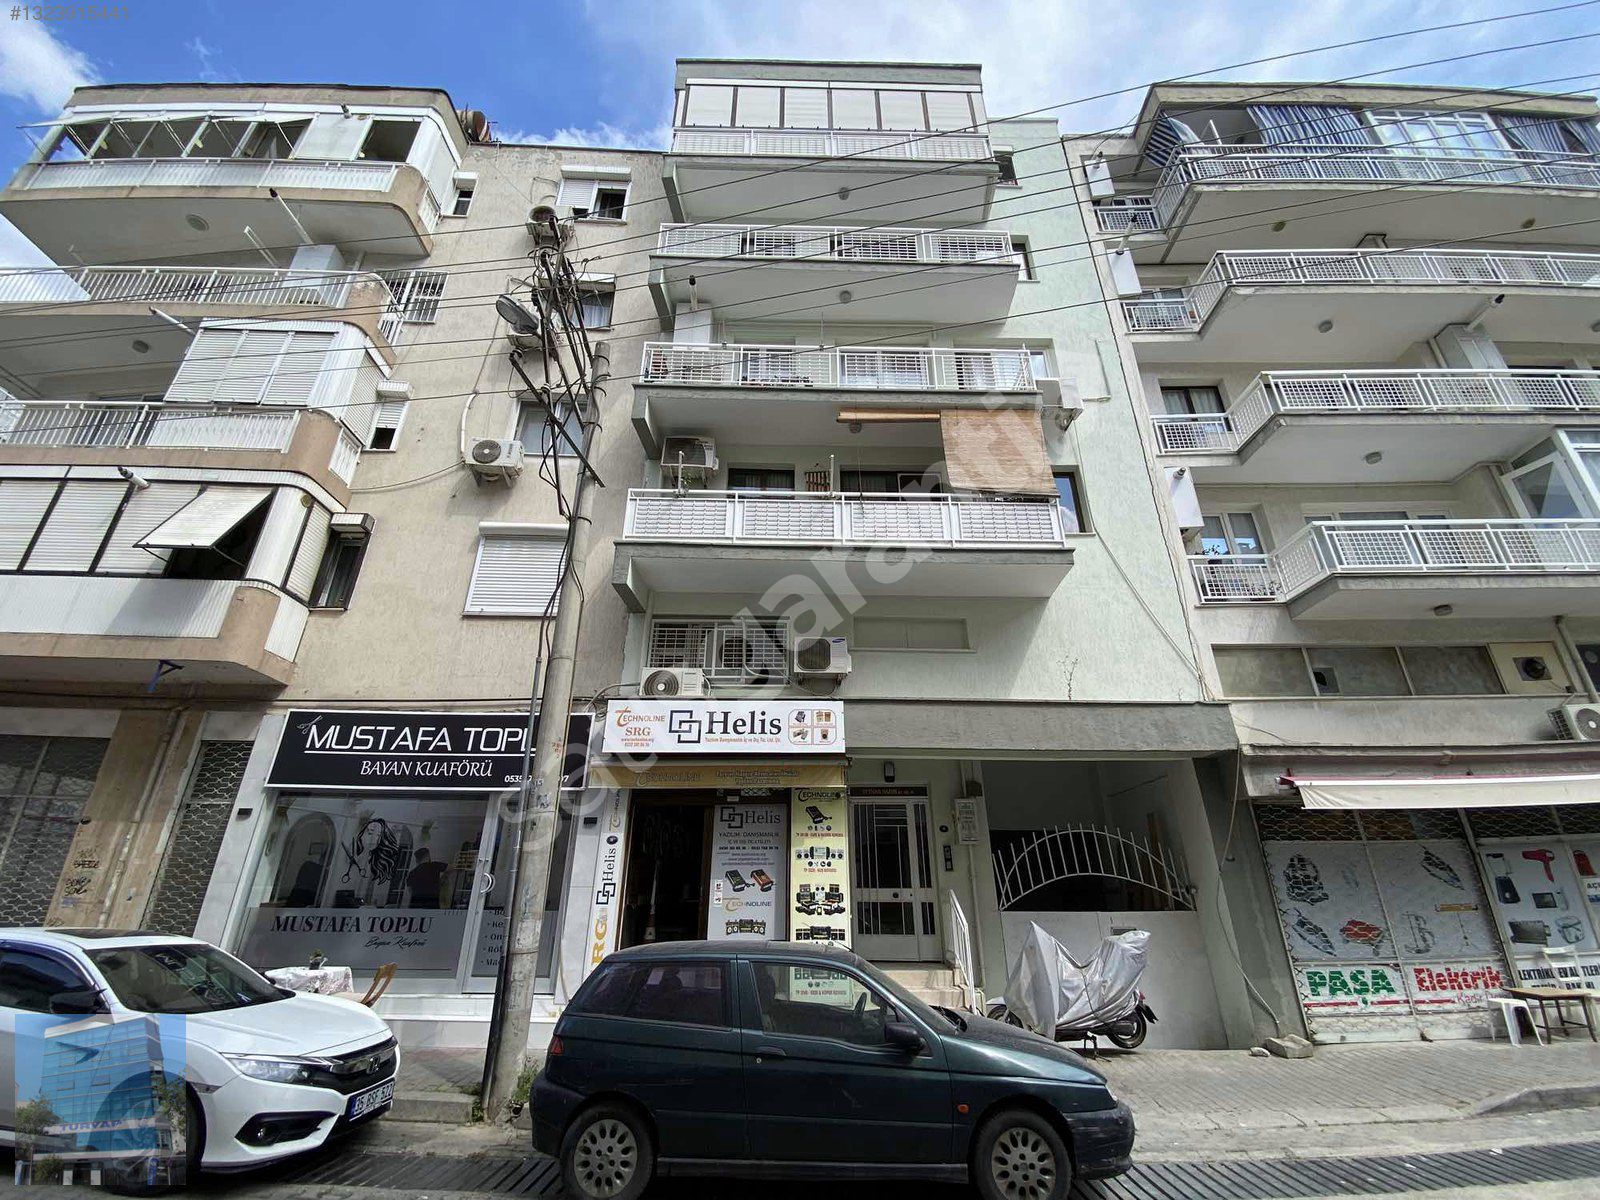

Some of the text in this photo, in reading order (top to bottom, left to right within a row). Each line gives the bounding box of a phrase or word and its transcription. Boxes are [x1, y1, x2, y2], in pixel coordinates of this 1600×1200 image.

[625, 727, 651, 736] SRG
[705, 711, 782, 735] Helis
[305, 725, 452, 751] MUSTAFA
[463, 727, 538, 752] TOPL
[360, 760, 493, 777] BAYAN KUAFÖRÜ
[745, 810, 781, 824] Helis
[602, 848, 617, 883] Helis
[270, 915, 434, 934] MUSTAFA TOPLU
[591, 919, 608, 965] RG
